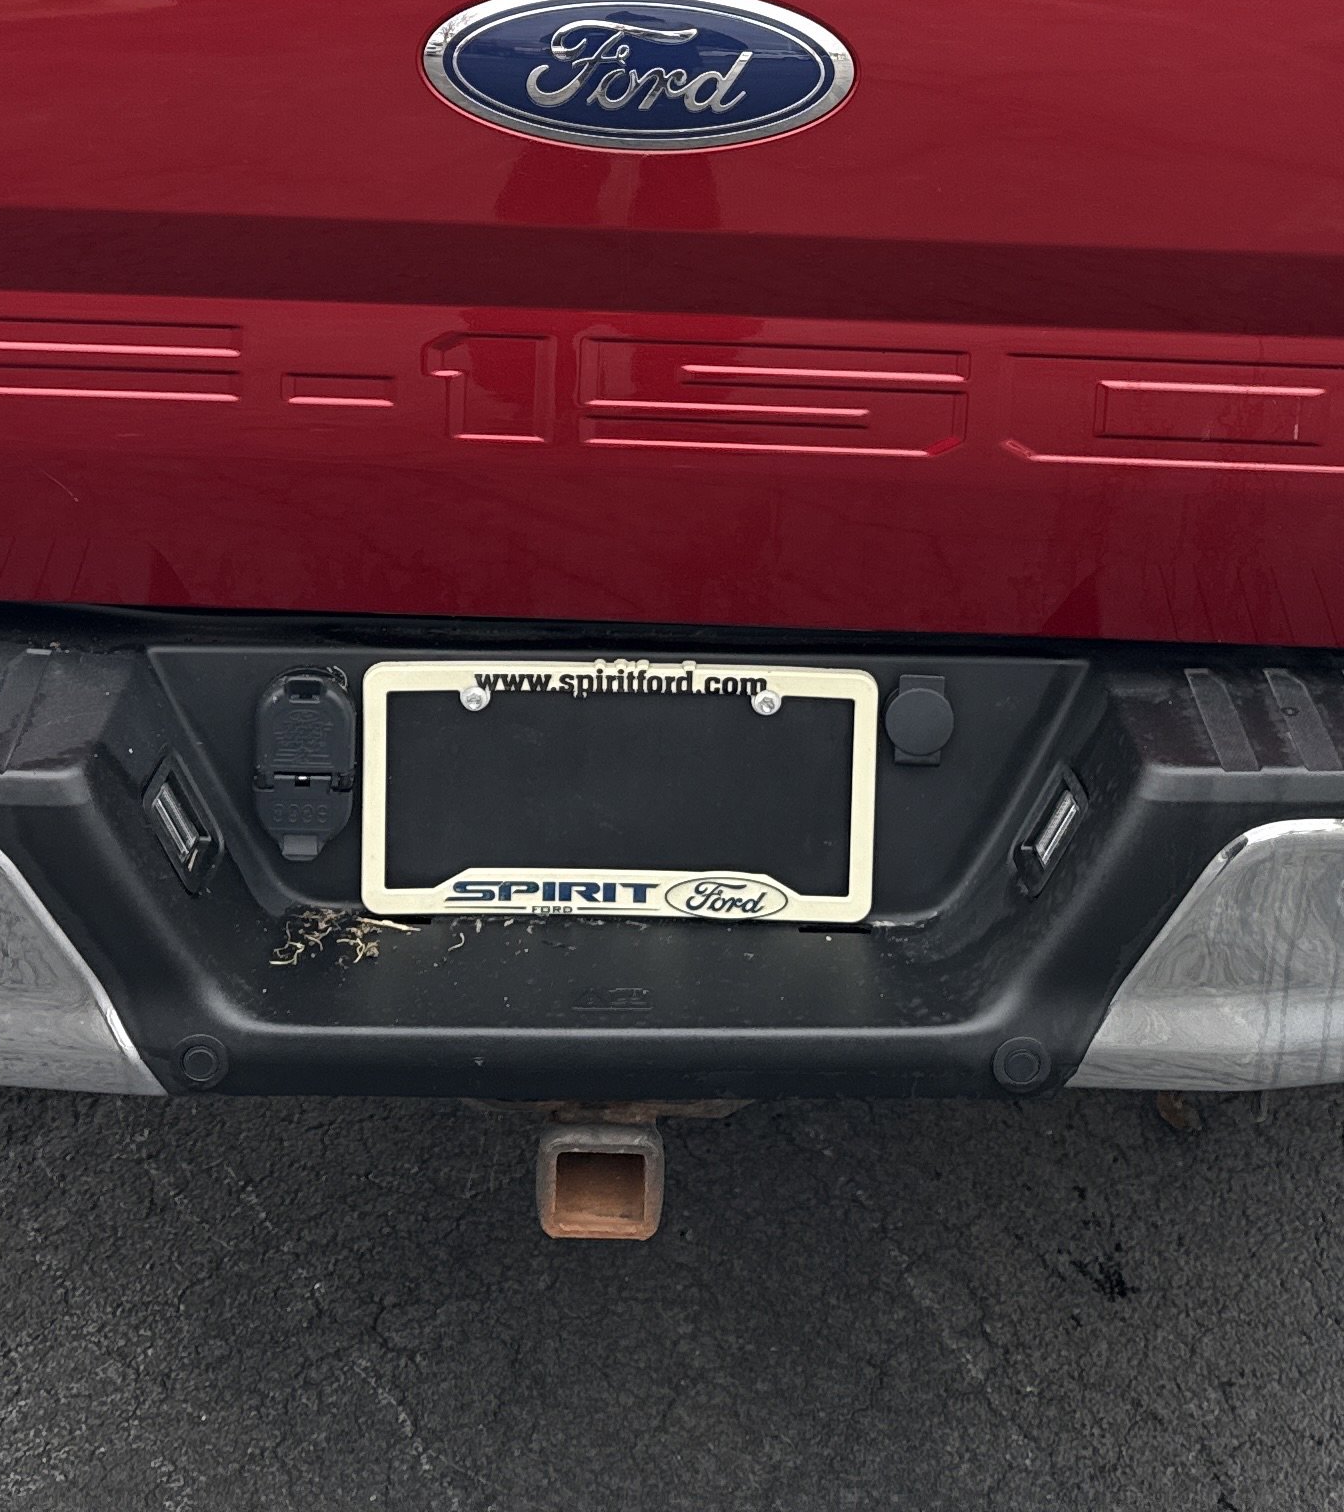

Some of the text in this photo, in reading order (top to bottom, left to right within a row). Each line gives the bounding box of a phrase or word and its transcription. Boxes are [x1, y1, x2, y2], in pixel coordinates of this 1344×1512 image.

[526, 19, 753, 114] Ford
[474, 668, 768, 698] www.spiritford.com
[444, 878, 768, 914] SPIRIT Ford
[531, 904, 573, 915] FORD
